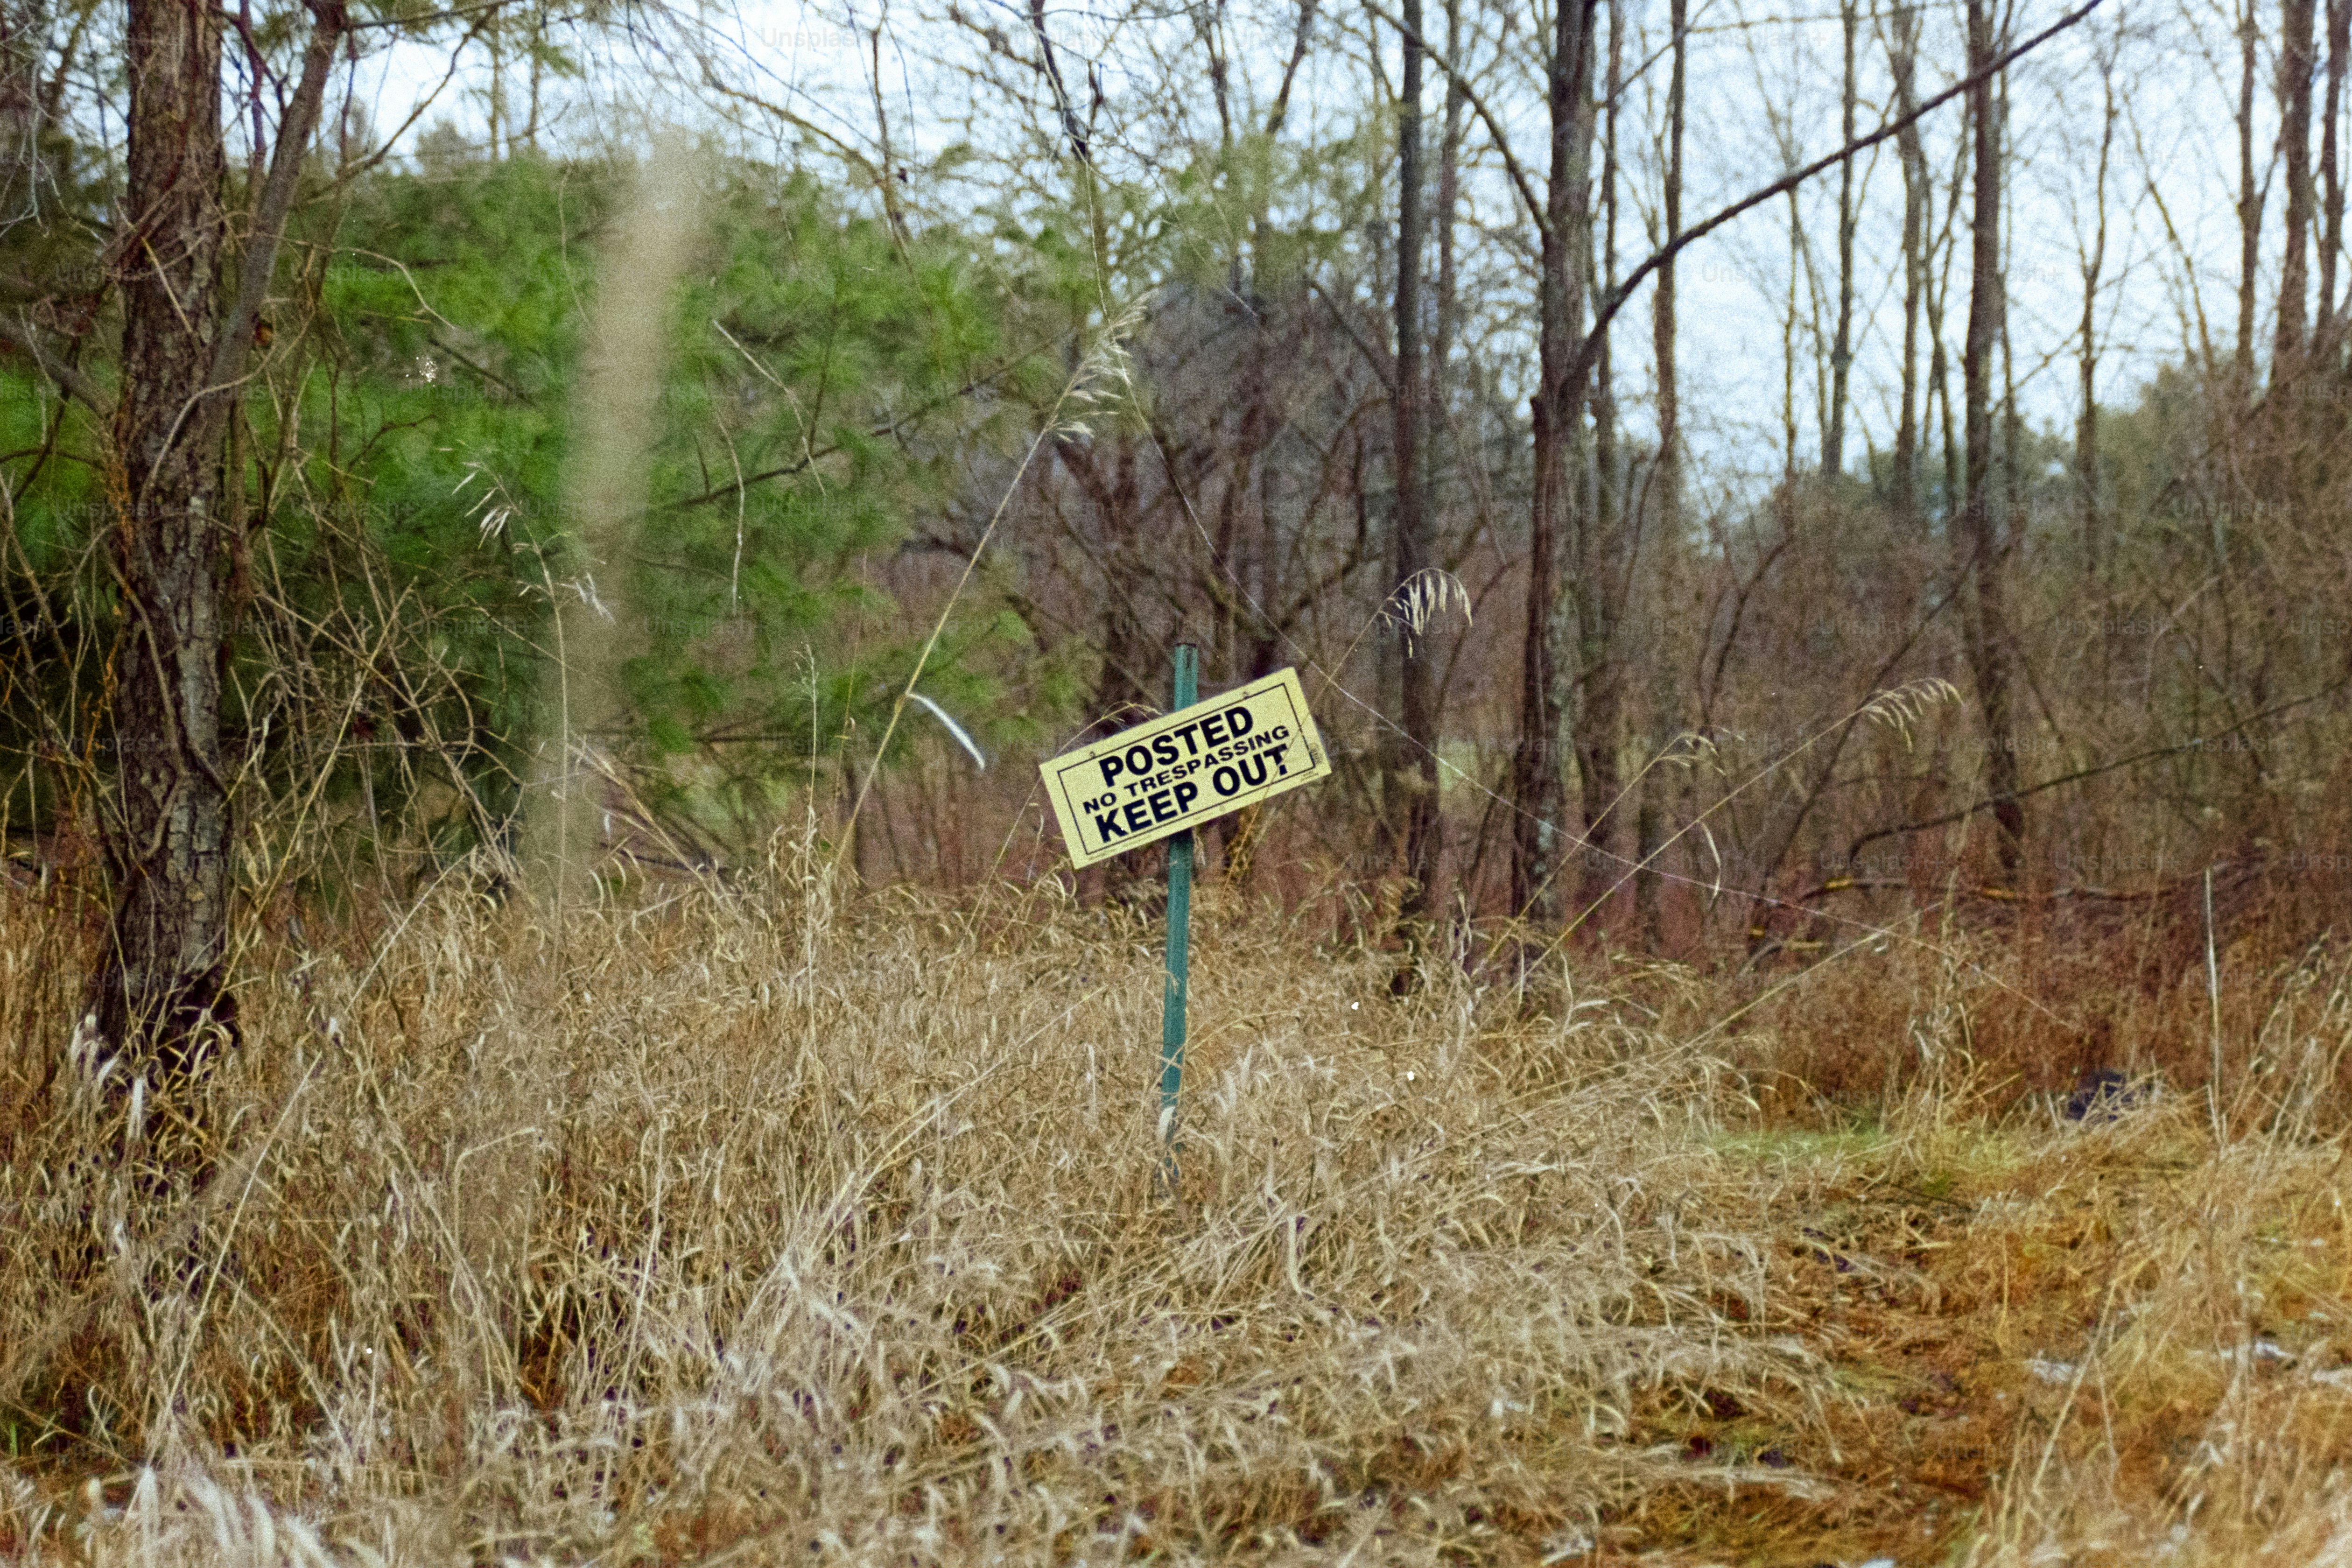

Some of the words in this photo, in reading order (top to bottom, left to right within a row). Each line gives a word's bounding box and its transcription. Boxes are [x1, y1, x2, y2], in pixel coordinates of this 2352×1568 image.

[1083, 792, 1116, 814] NO
[1124, 725, 1289, 796] TRESPASSING
[1098, 706, 1253, 788] POSTED
[1095, 781, 1198, 843] KEEP
[1212, 743, 1288, 796] OUT
